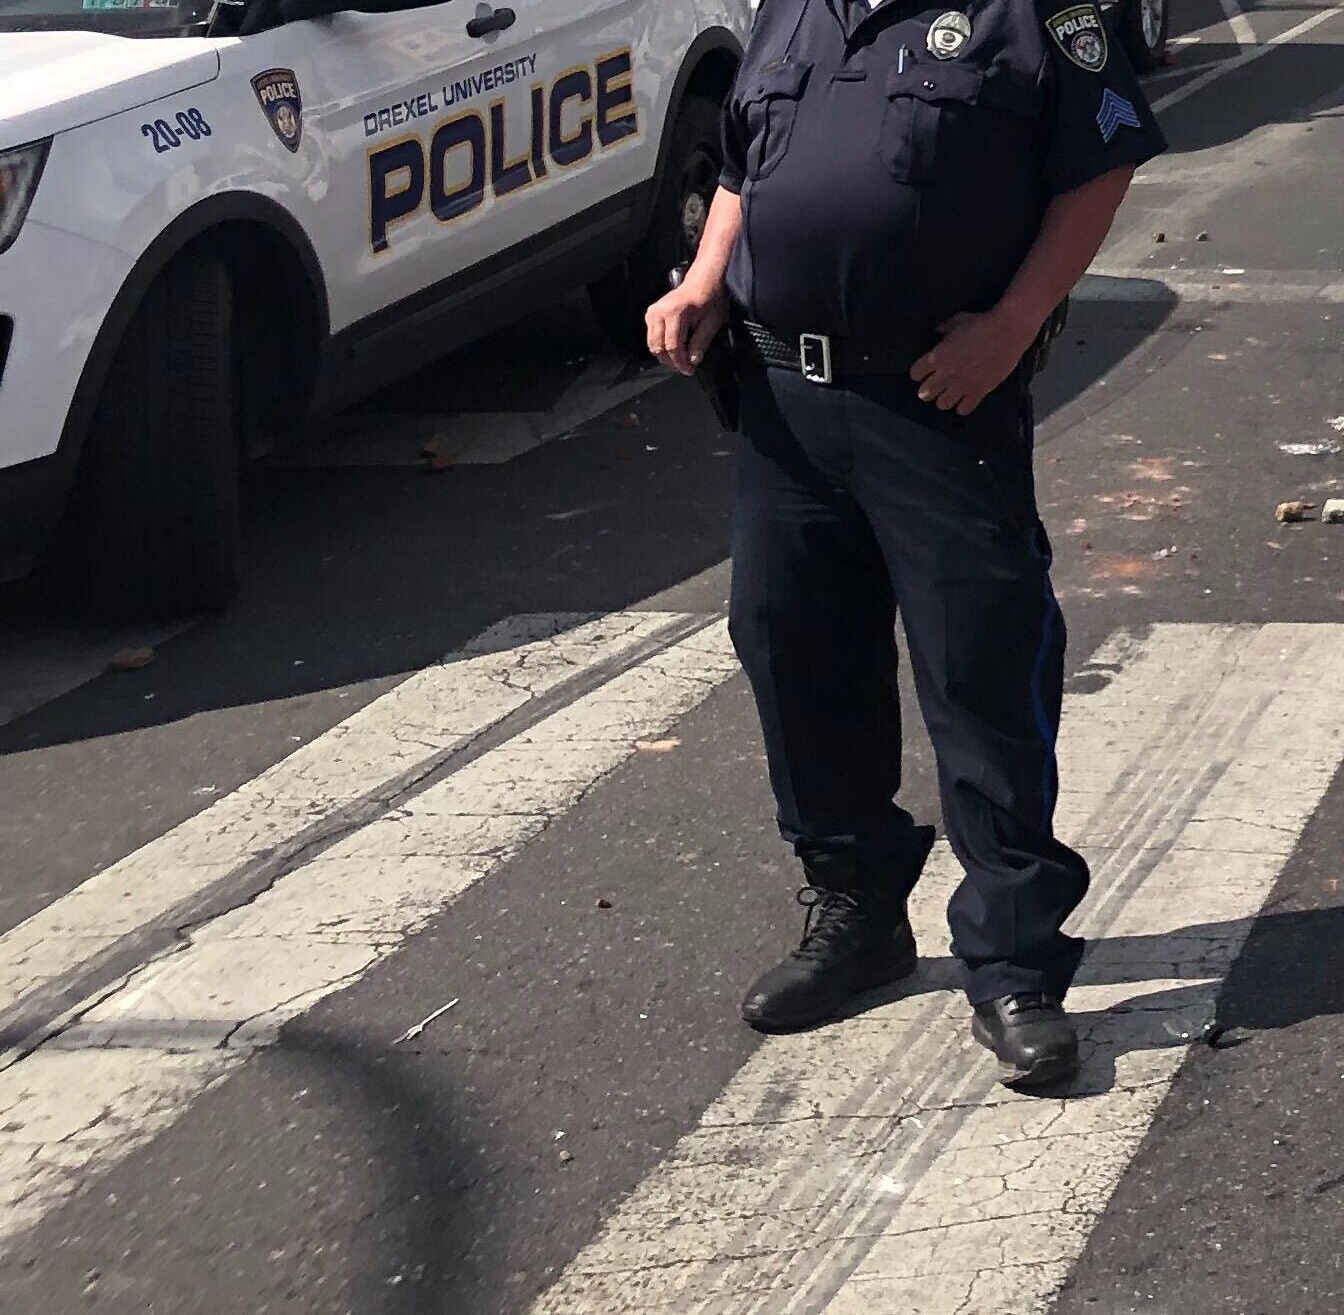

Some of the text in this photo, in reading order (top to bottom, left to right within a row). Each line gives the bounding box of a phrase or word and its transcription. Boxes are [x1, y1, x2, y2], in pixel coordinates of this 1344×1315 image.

[1056, 14, 1099, 41] POLICE
[259, 81, 297, 106] POLICE
[363, 53, 537, 137] DREXEL UNIVERSITY
[141, 107, 212, 153] 20-08
[367, 45, 641, 259] POLICE
